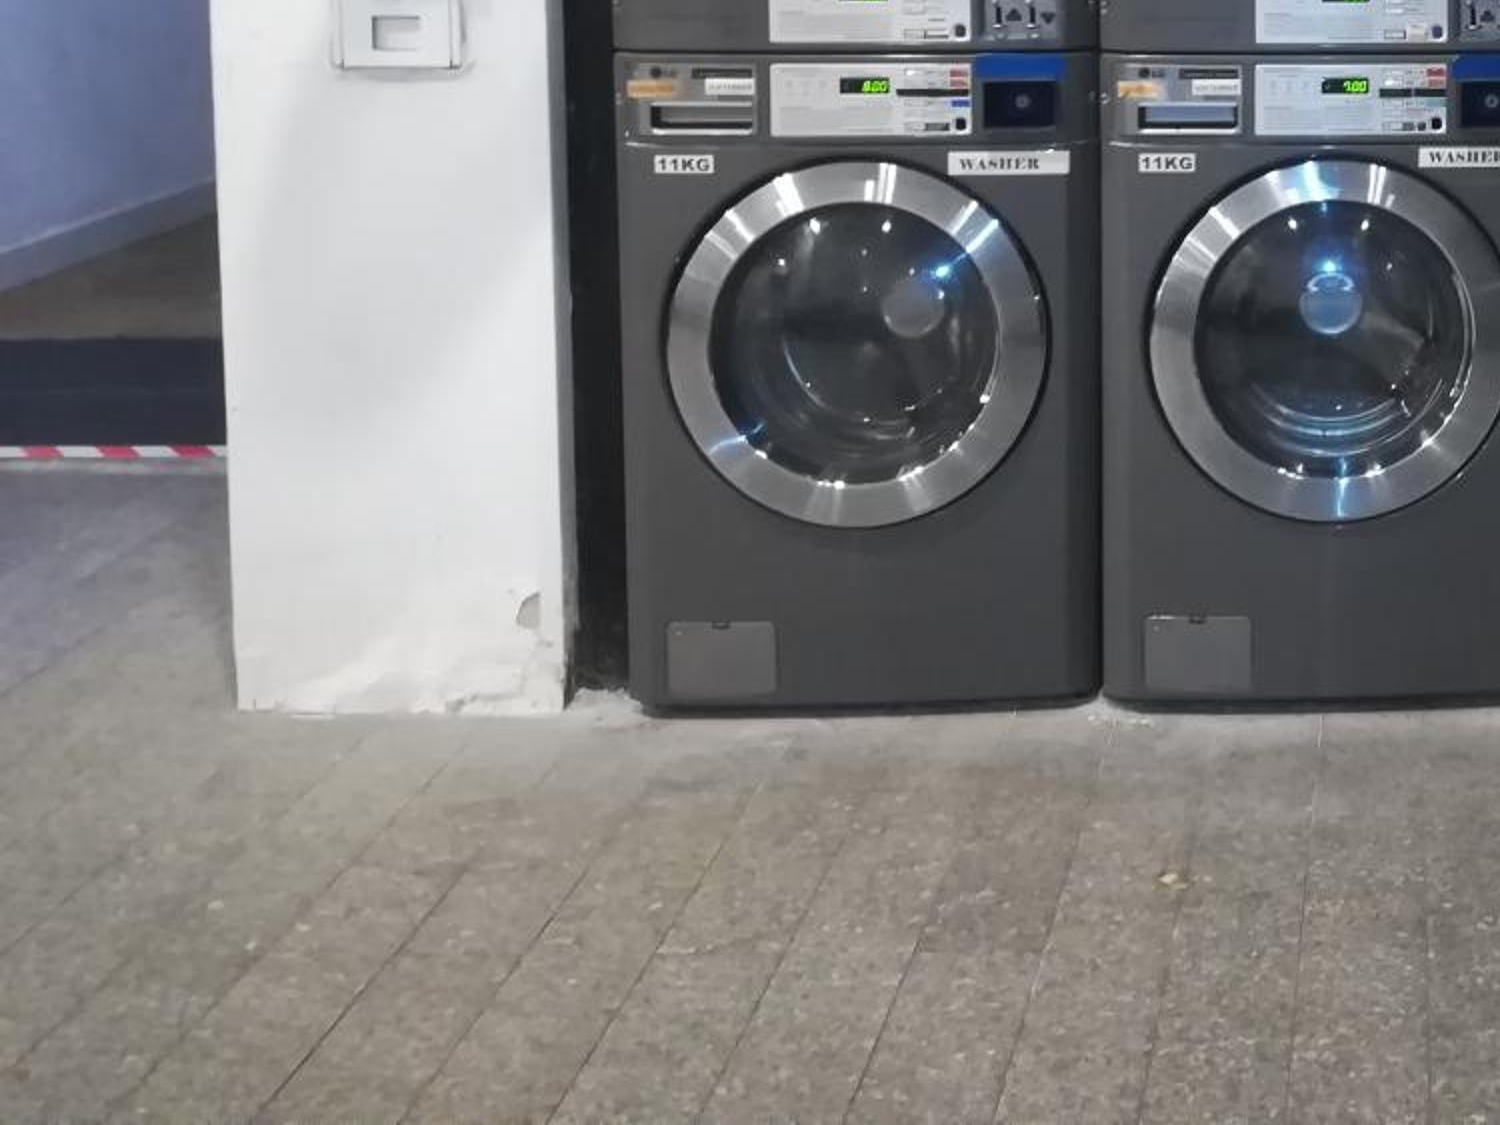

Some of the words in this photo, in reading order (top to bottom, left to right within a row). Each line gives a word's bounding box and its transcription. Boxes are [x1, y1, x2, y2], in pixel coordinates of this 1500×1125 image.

[658, 157, 710, 173] 11KG
[959, 156, 1040, 171] WASHER
[1142, 156, 1194, 172] 11KG
